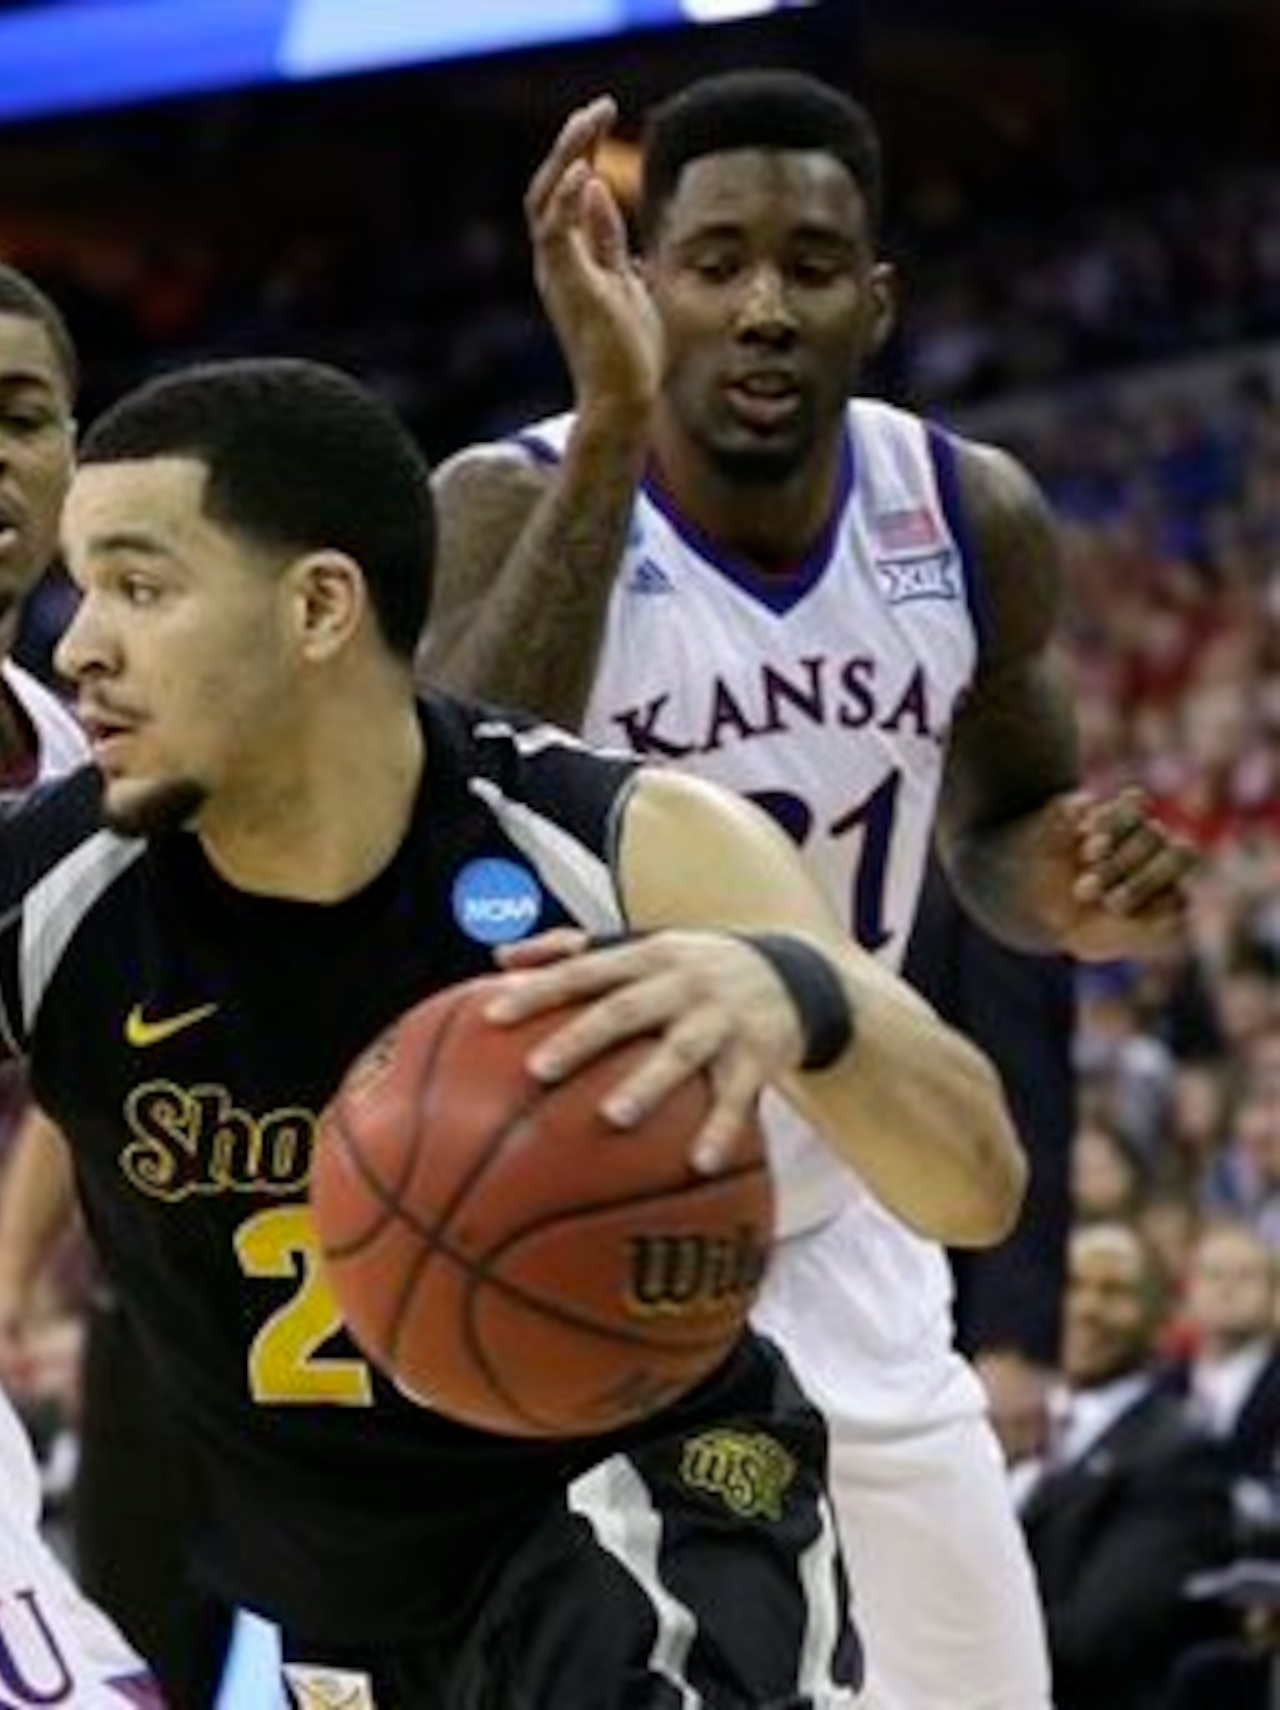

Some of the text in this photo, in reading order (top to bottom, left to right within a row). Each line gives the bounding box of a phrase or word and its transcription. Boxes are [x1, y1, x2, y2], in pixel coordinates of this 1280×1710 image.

[613, 656, 942, 760] KANSA
[740, 767, 903, 950] 1
[232, 1204, 372, 1406] 2
